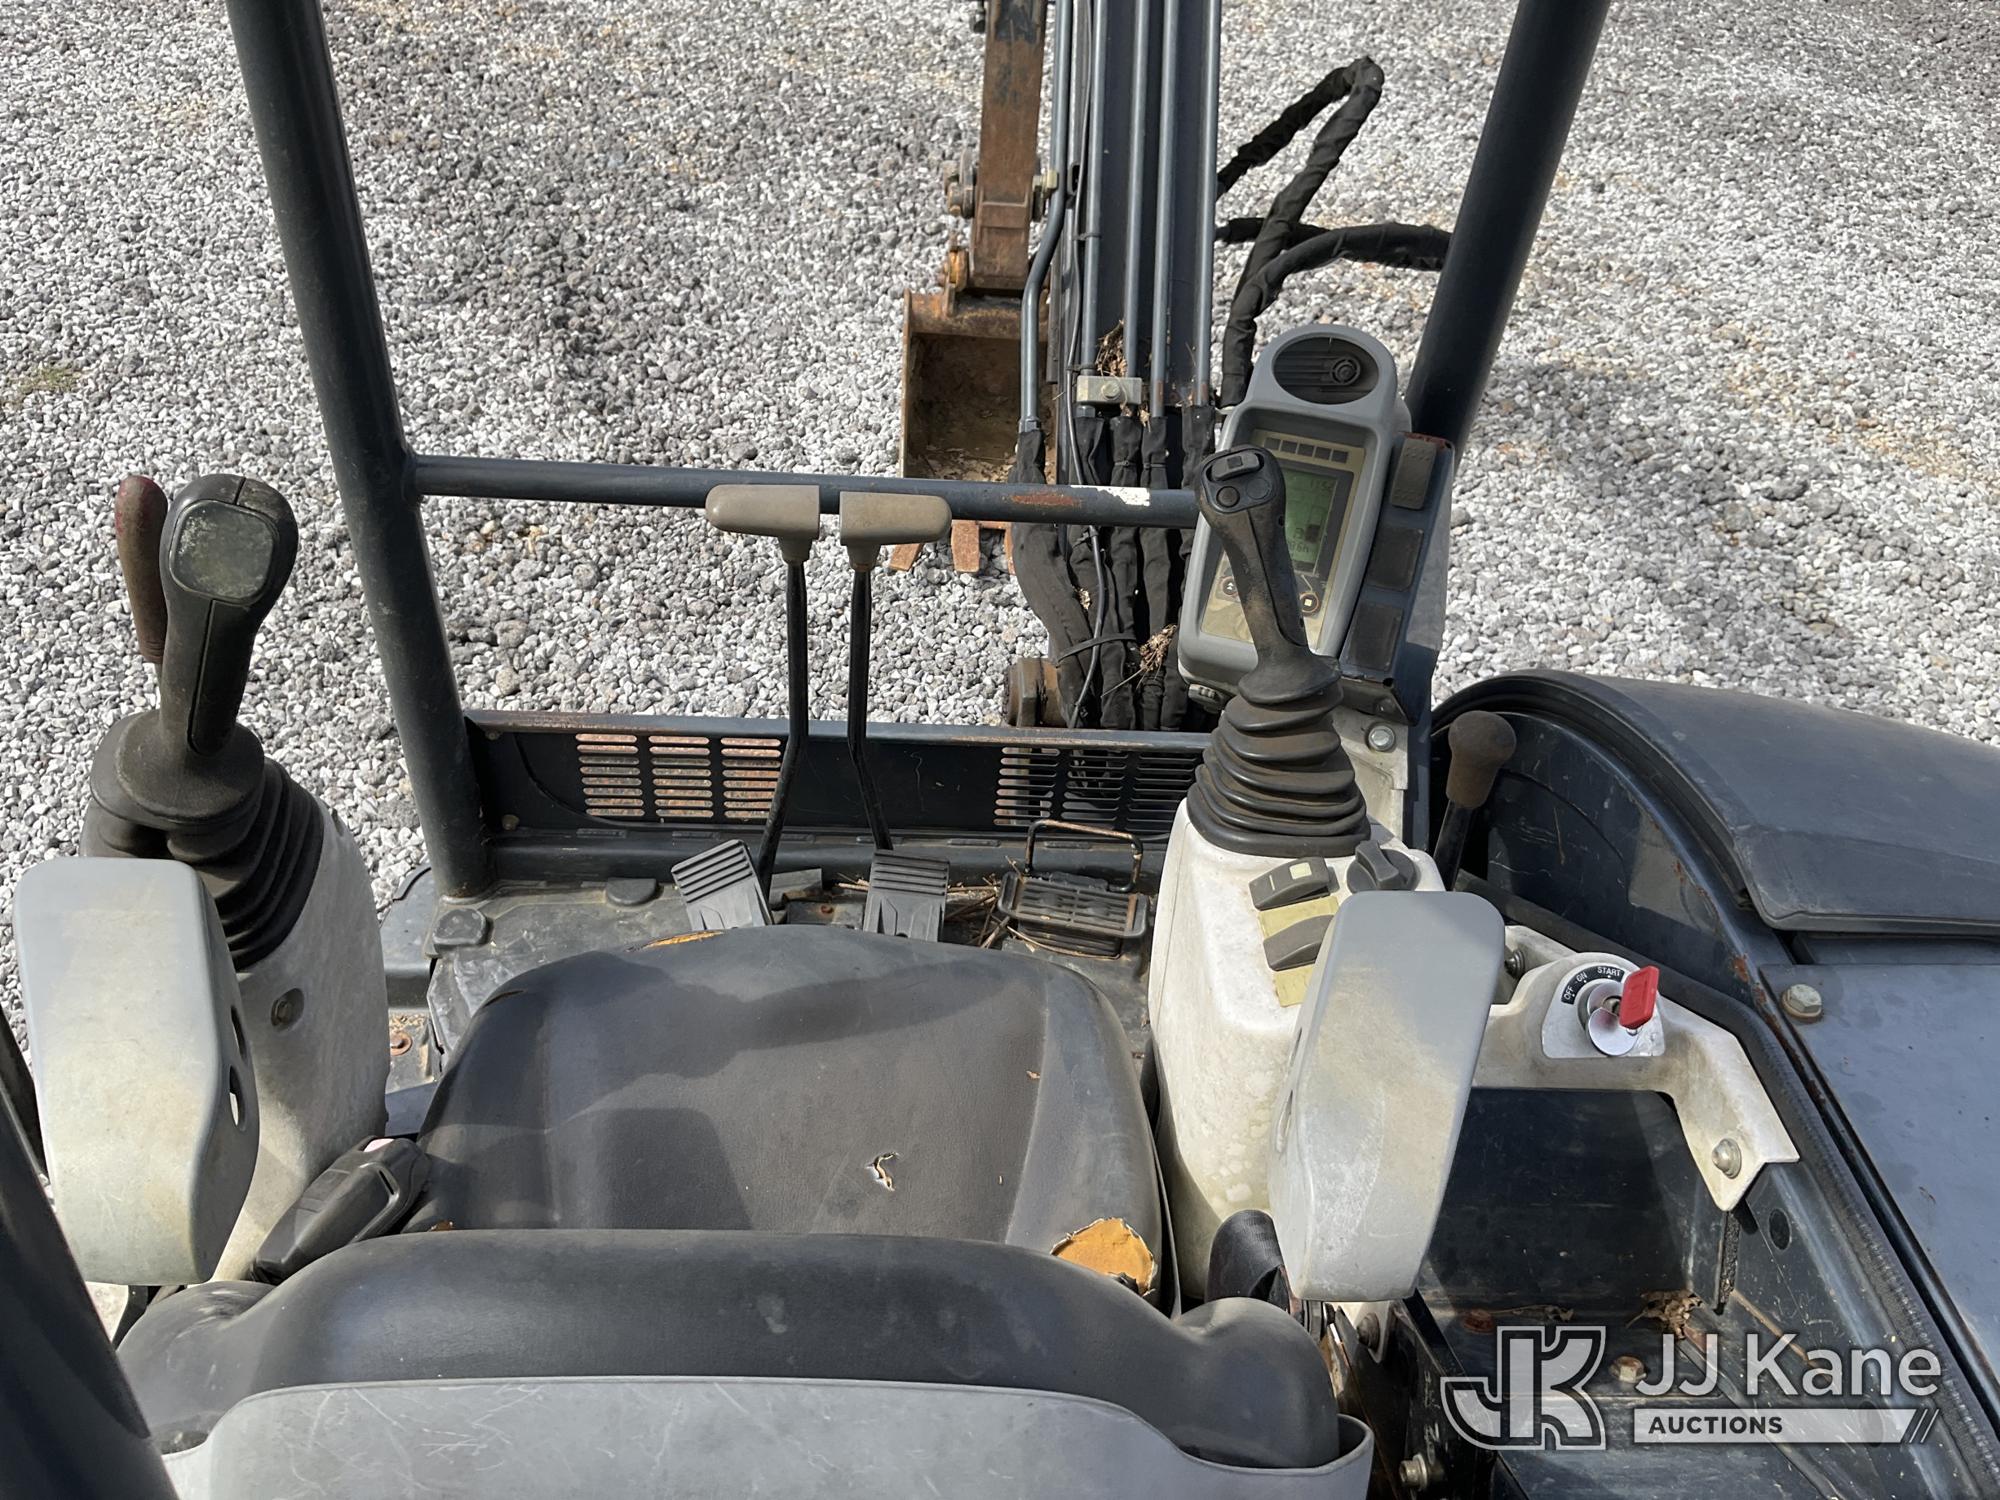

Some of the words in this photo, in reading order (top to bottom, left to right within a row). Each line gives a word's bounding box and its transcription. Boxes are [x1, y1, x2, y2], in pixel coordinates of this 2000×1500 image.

[1563, 986, 1574, 1000] OFF
[1576, 971, 1588, 982] ON
[1597, 966, 1621, 976] START
